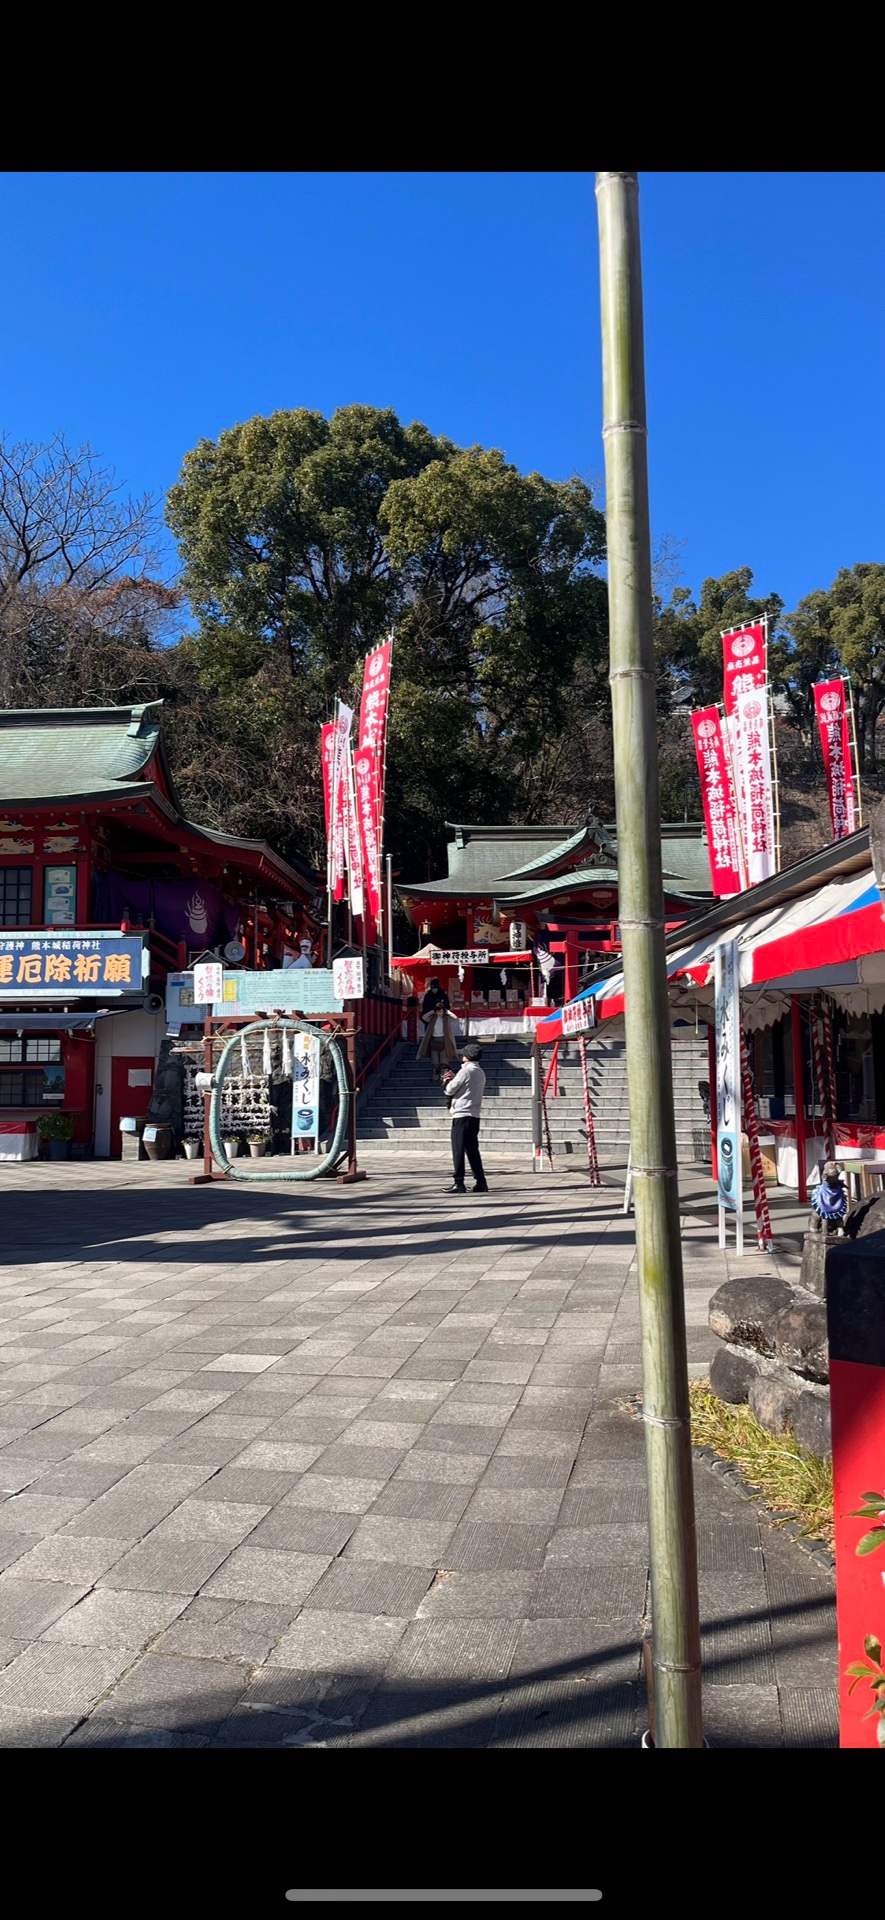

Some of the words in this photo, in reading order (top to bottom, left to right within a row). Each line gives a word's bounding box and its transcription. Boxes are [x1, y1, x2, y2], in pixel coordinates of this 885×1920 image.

[31, 940, 101, 951] 熊本城稲荷神社
[432, 950, 487, 961] 御神符授与所
[0, 953, 132, 984] 運厄除祈願
[720, 995, 731, 1126] 水みくじ
[301, 1052, 311, 1105] 水みくじ
